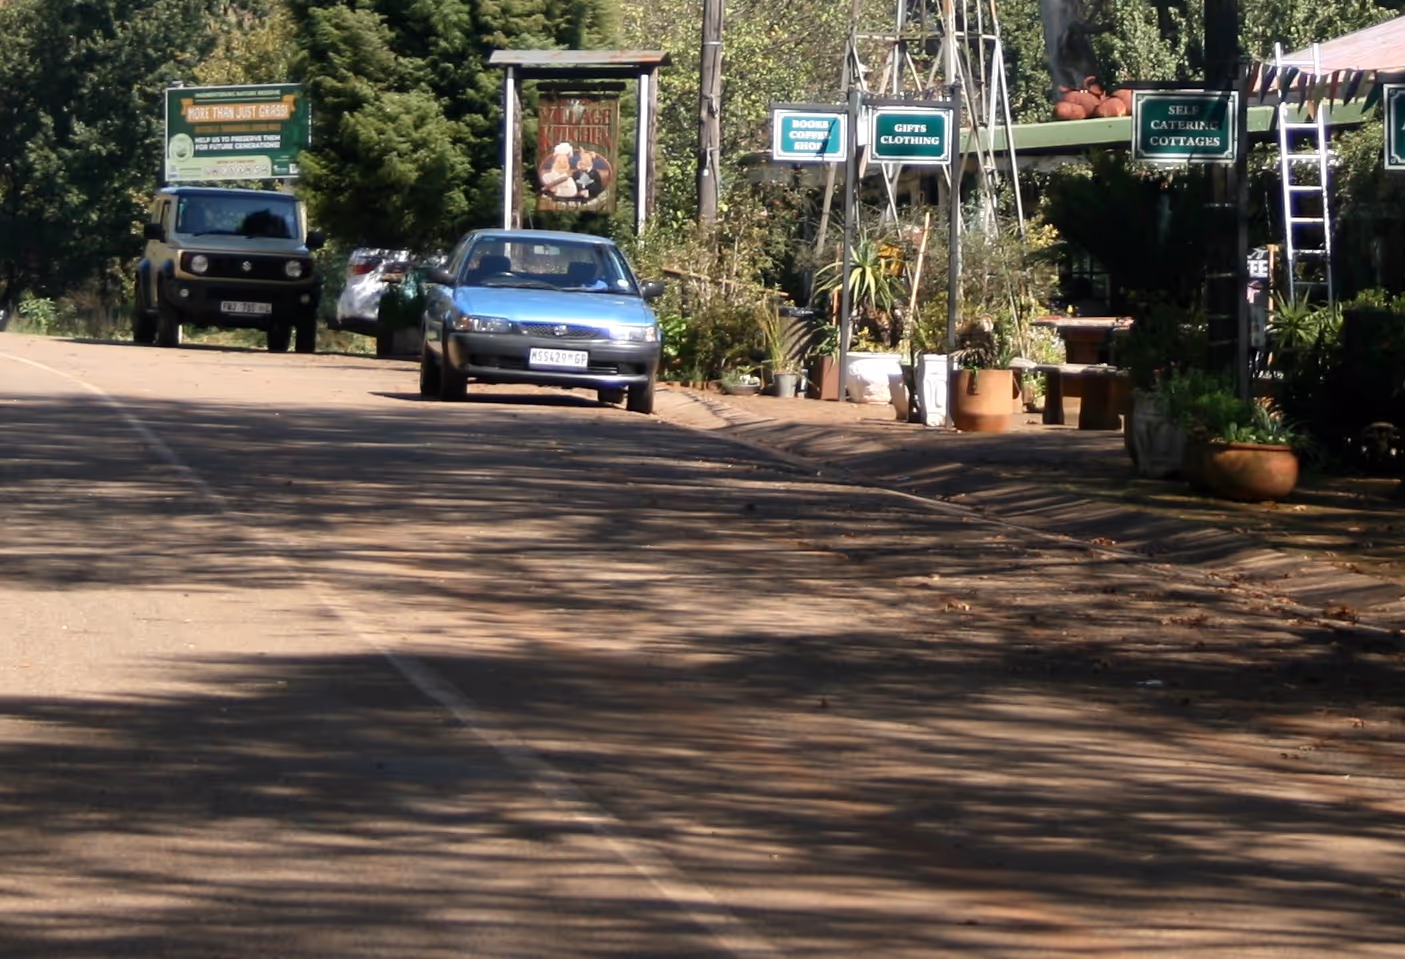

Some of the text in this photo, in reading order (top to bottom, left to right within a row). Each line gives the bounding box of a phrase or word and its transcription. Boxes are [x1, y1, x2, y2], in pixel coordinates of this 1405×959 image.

[187, 106, 209, 120] MORE
[211, 105, 234, 120] THAN
[235, 105, 257, 119] JUST
[1168, 105, 1199, 115] SELF
[541, 106, 611, 125] VILLAGE
[791, 119, 829, 129] BOOKS
[894, 123, 927, 133] GIFTS
[1150, 120, 1219, 130] CATERING
[880, 135, 939, 145] CLOTHING
[1150, 136, 1220, 146] COTTAGES
